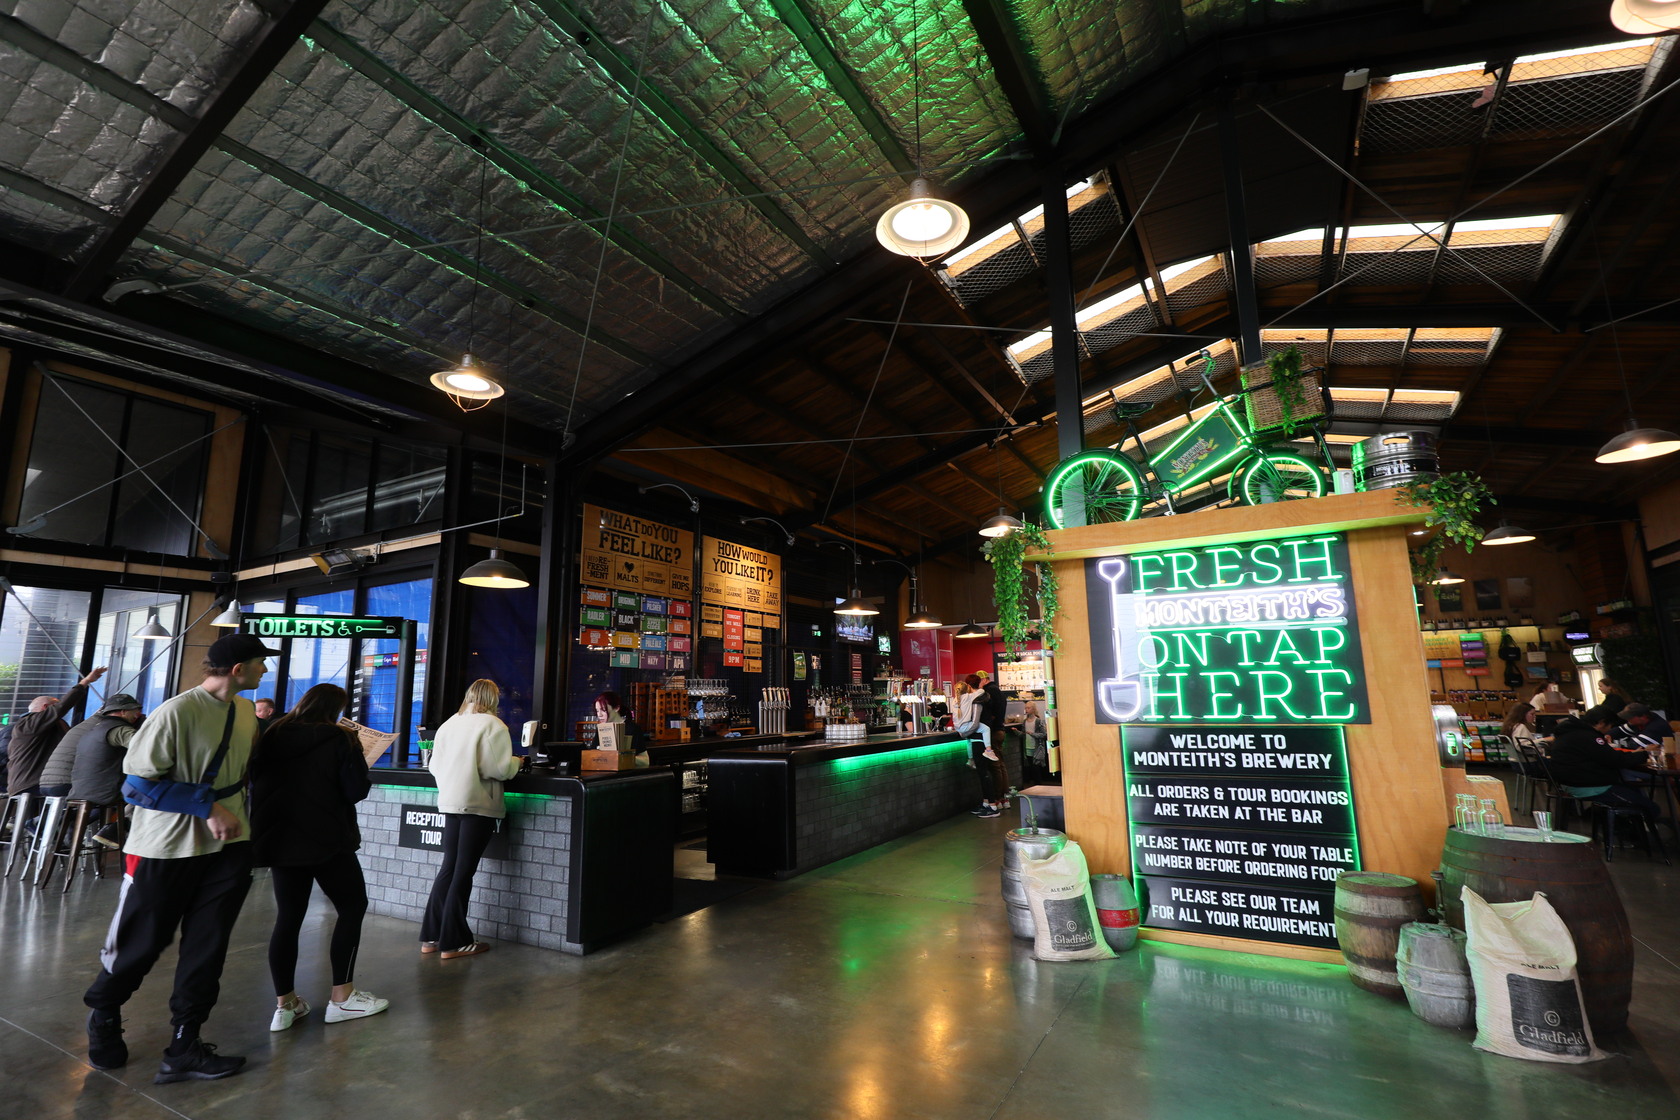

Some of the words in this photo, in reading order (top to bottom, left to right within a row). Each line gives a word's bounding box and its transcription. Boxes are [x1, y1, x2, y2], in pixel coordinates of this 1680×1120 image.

[600, 510, 640, 534] WHAT
[642, 525, 653, 537] DO
[652, 524, 678, 544] YOU
[599, 531, 639, 557] FEEL
[642, 541, 681, 564] LIKE?
[718, 541, 741, 559] HOW
[742, 550, 768, 565] WOULD
[587, 562, 609, 572] FRESH
[712, 558, 734, 575] YOU
[736, 563, 755, 579] LIKE
[1132, 536, 1343, 593] FRESH
[617, 572, 639, 584] MALTS
[672, 580, 689, 591] HOPS
[748, 595, 760, 603] HERE
[765, 599, 779, 607] AWAY
[766, 591, 778, 599] TAKE
[588, 611, 605, 621] RADLER
[676, 606, 685, 614] IPA
[1135, 588, 1345, 627] MONTEITH'S
[244, 618, 334, 636] TOILETS
[618, 614, 634, 625] BLACK
[1138, 632, 1212, 669] ON
[1227, 627, 1345, 666] TAP
[620, 654, 631, 664] MID
[674, 659, 684, 669] APA
[1140, 670, 1354, 720] HERE
[1170, 734, 1256, 750] WELCOME
[1261, 734, 1286, 750] TO
[1134, 752, 1236, 768] MONTEITH'S
[1242, 753, 1332, 770] BREWERY
[1130, 784, 1154, 798] ALL
[1158, 785, 1210, 800] ORDERS
[1214, 787, 1224, 800] &
[1228, 787, 1266, 802] TOUR
[1271, 789, 1349, 806] BOOKINGS
[406, 811, 446, 828] RECEPTIO
[1154, 803, 1179, 817] ARE
[1183, 804, 1230, 819] TAKEN
[1234, 806, 1252, 820] AT
[1257, 807, 1287, 822] THE
[1292, 809, 1323, 824] BAR
[420, 830, 442, 846] TOUR
[1136, 835, 1178, 851] PLEASE
[1182, 838, 1212, 853] TAKE
[1215, 840, 1249, 856] NOTE
[1252, 842, 1267, 857] OF
[1272, 844, 1307, 859] YOUR
[1310, 846, 1354, 863] TABLE
[1145, 853, 1192, 870] NUMBER
[1196, 856, 1241, 874] BEFORE
[1245, 860, 1307, 880] ORDERING
[1171, 887, 1217, 904] PLEASE
[1222, 892, 1246, 908] SEE
[1250, 895, 1277, 912] OUR
[1280, 897, 1320, 916] TEAM
[1152, 904, 1174, 921] FOR
[1179, 908, 1201, 923] ALL
[1205, 910, 1239, 928] YOUR
[1054, 931, 1092, 944] Gladfield
[1520, 1024, 1585, 1045] Gladfield
